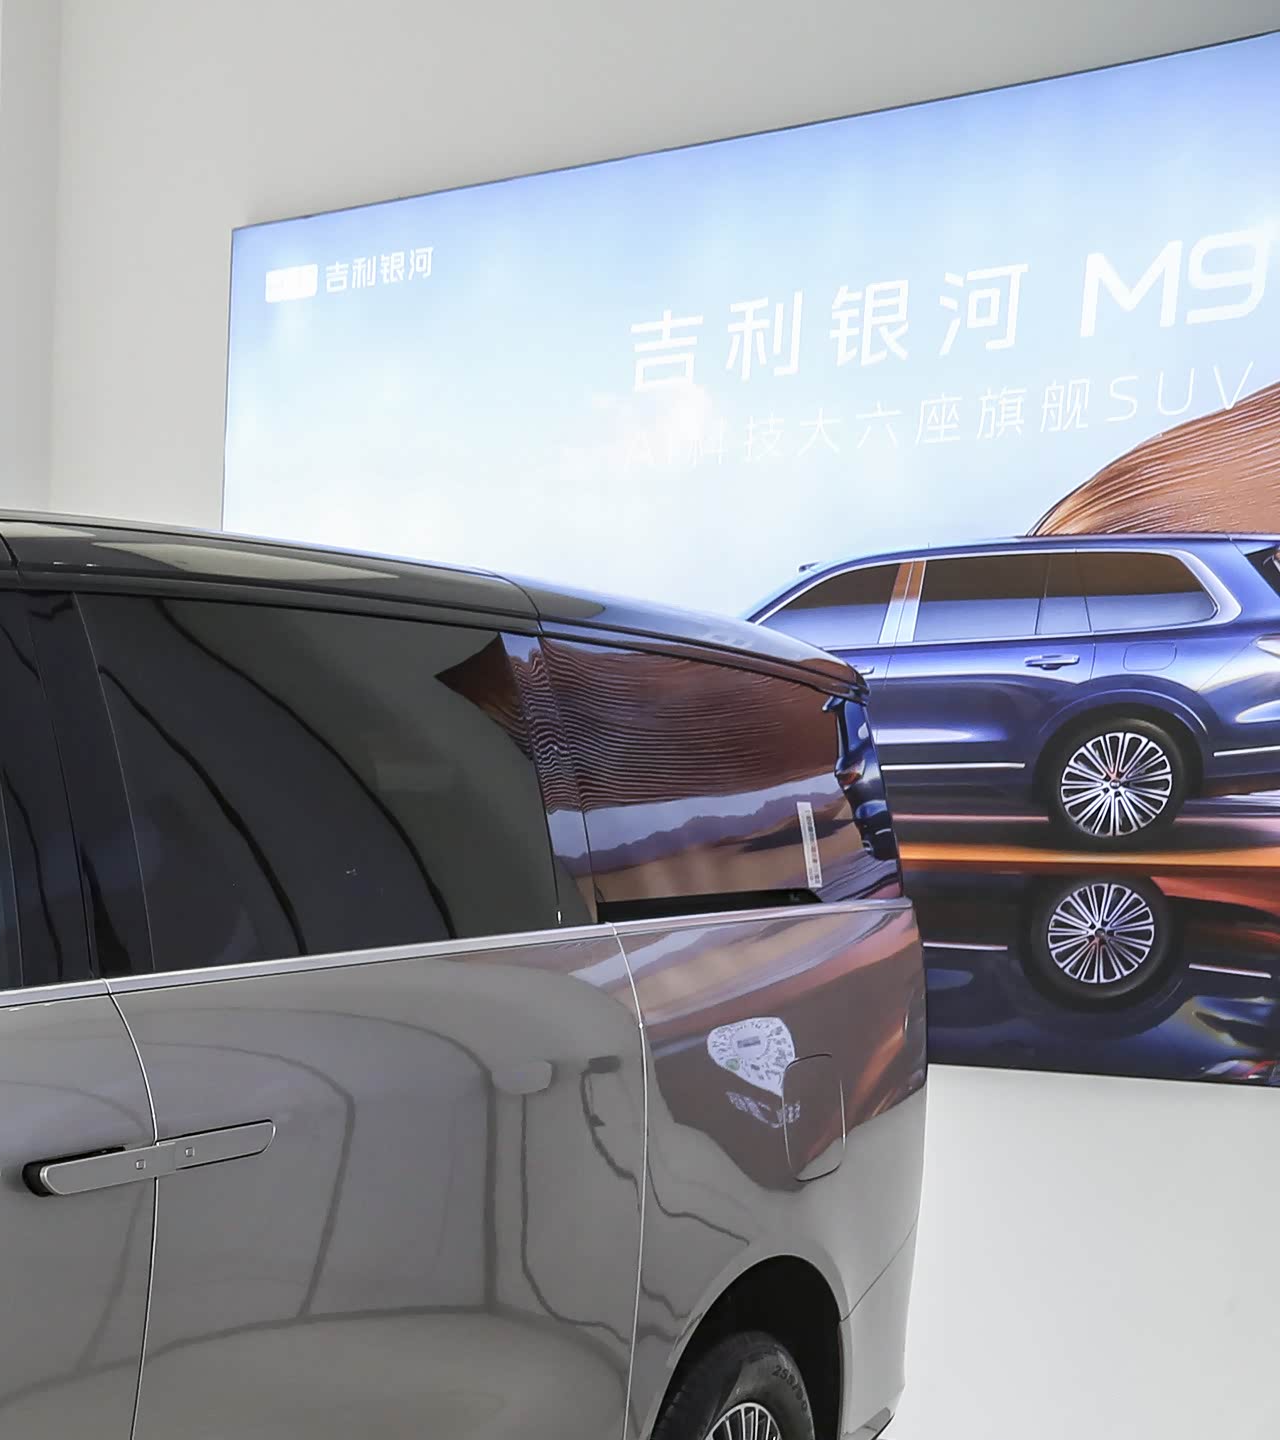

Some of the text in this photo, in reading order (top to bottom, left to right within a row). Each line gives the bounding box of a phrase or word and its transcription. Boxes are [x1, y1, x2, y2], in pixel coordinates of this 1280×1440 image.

[325, 246, 434, 293] 吉利银河
[629, 231, 1271, 392] 吉利银河 M9
